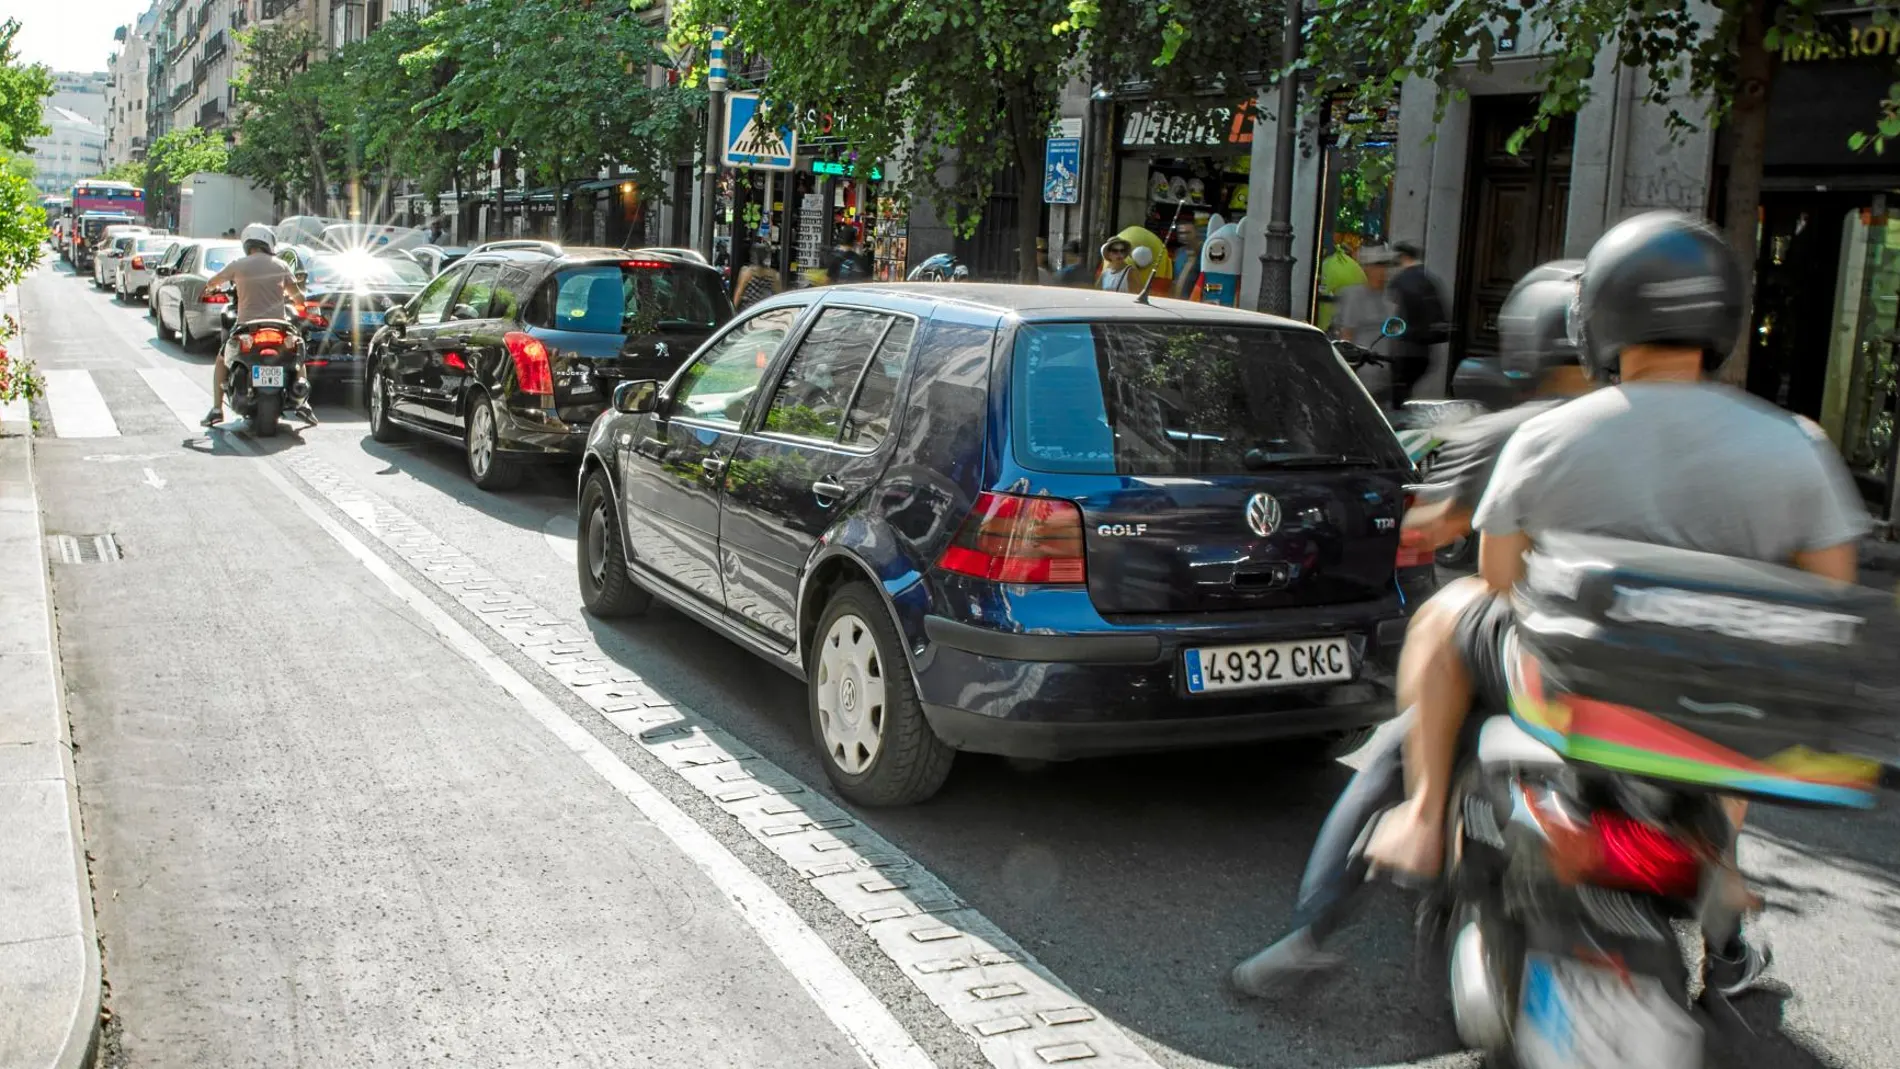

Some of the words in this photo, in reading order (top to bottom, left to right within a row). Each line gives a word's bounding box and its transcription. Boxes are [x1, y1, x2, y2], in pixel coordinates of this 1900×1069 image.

[1097, 524, 1147, 537] GOLF
[1209, 649, 1282, 684] 4932
[1291, 643, 1343, 677] CKC
[1193, 674, 1200, 684] E
